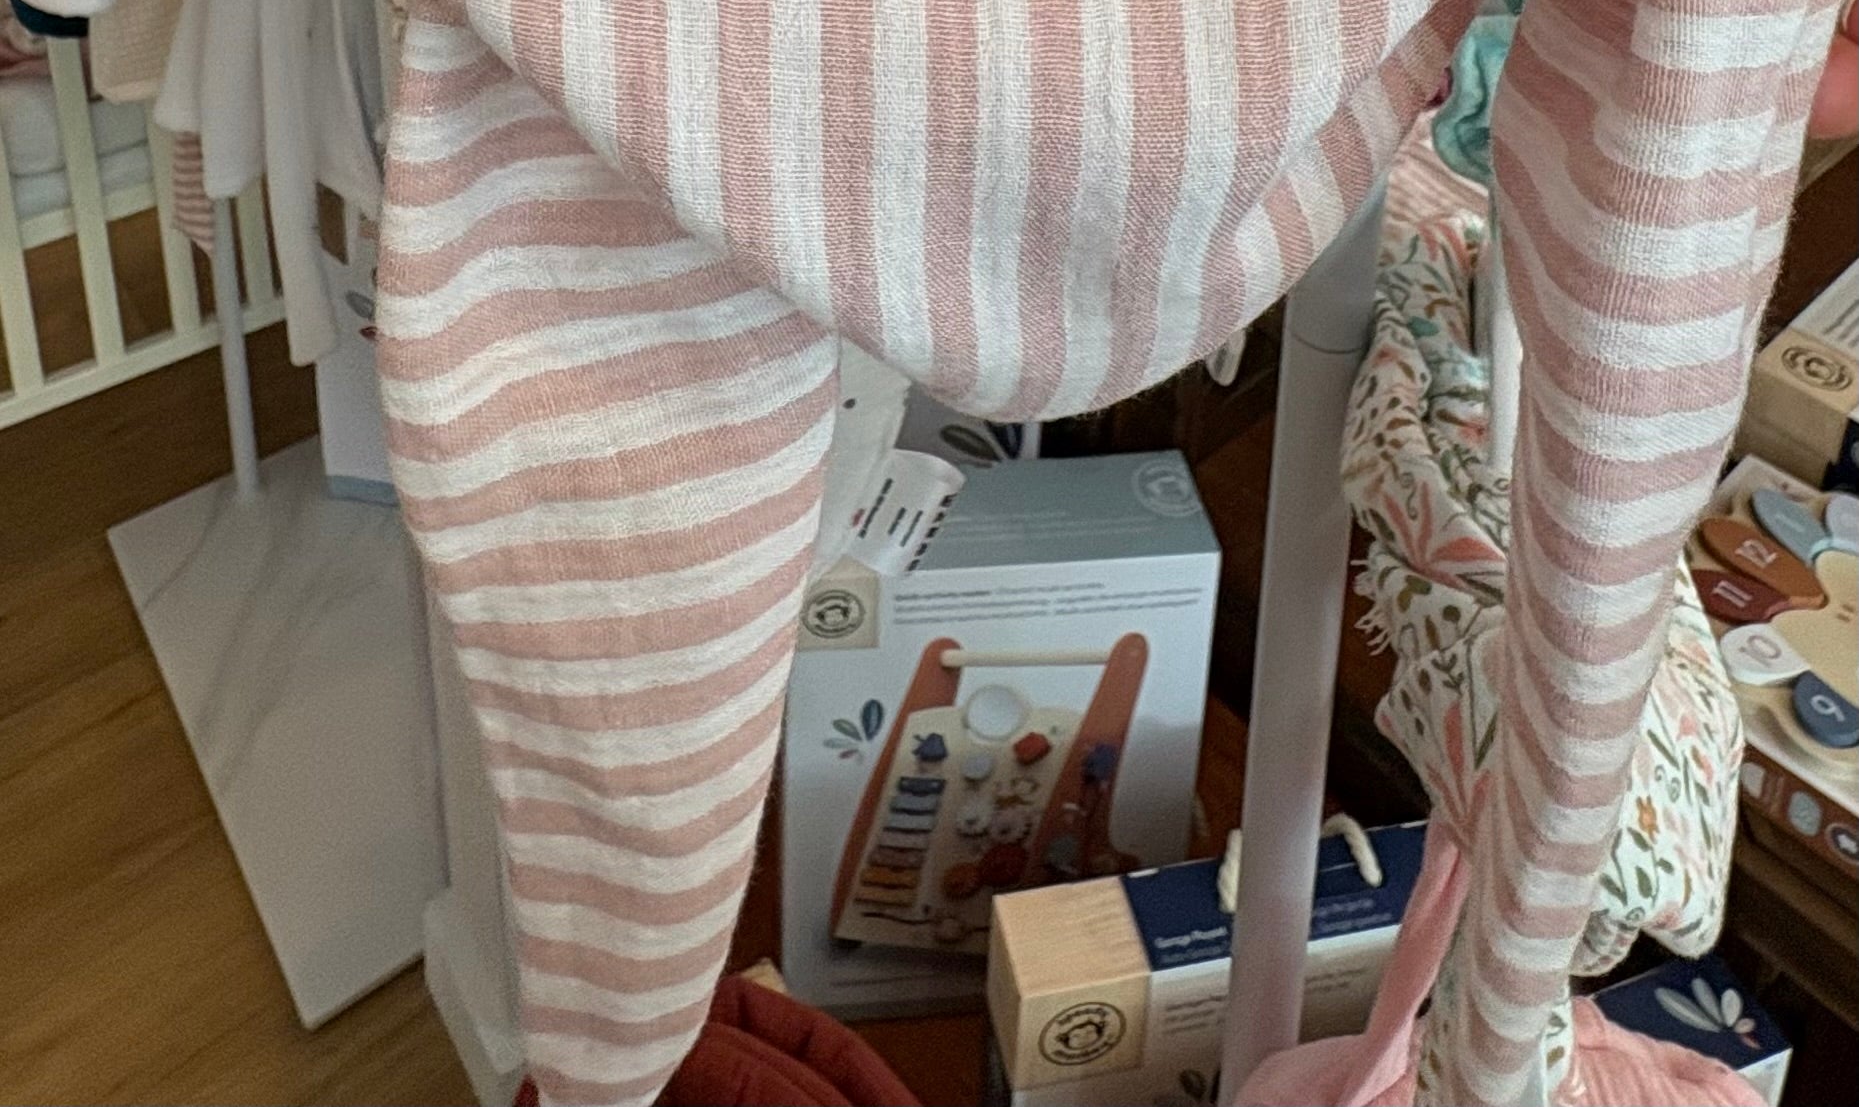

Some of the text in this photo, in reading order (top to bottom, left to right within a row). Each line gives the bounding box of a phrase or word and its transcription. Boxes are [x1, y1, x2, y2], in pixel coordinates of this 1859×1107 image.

[1734, 539, 1778, 569] 12
[1711, 579, 1753, 608] 11
[1738, 633, 1783, 667] 10
[1810, 693, 1846, 724] 9
